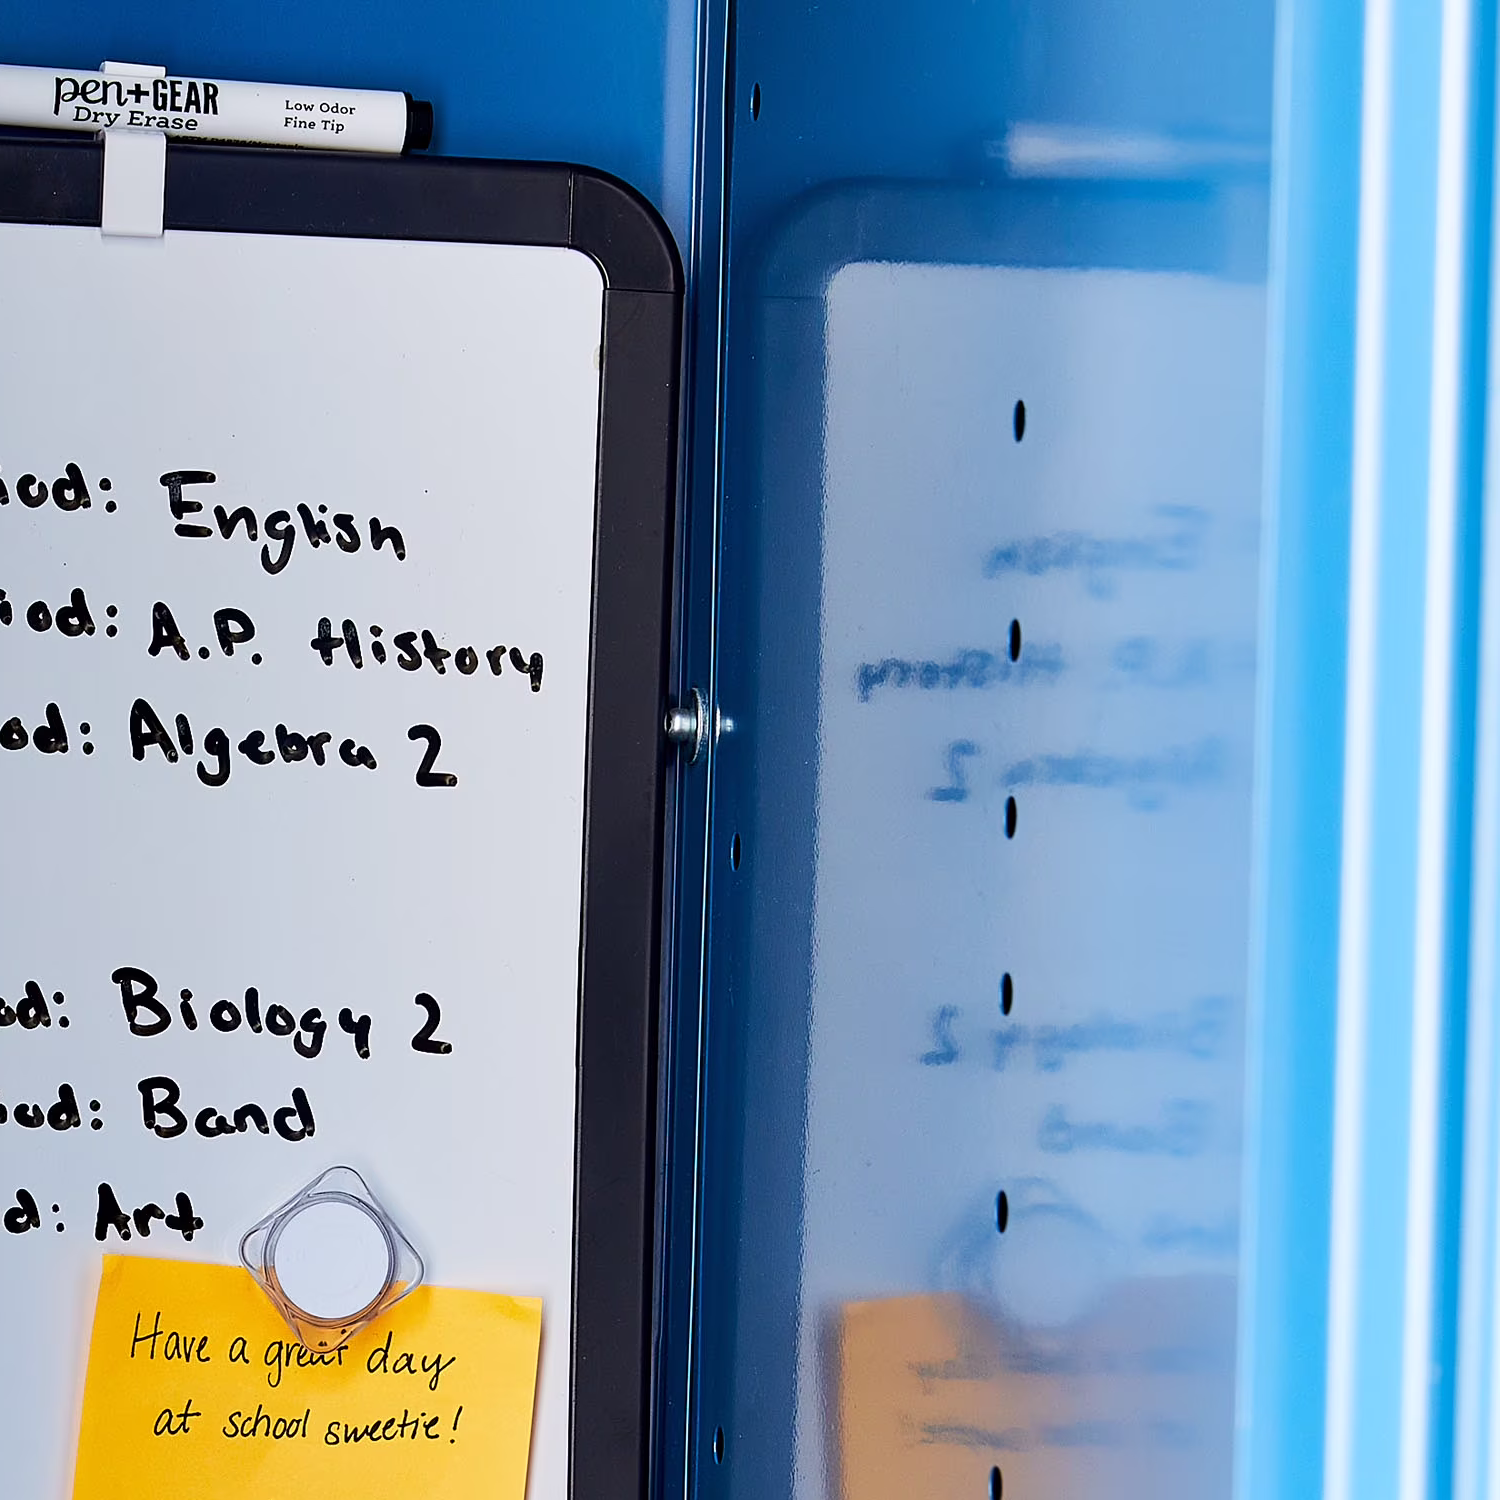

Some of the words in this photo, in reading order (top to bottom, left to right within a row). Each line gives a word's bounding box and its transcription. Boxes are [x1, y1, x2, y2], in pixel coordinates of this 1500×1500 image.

[71, 105, 121, 130] Dry
[126, 107, 200, 131] Erase
[283, 116, 316, 130] Fine
[320, 119, 345, 135] Tip
[285, 99, 315, 112] Low
[319, 102, 356, 115] Odor
[159, 470, 406, 575] English
[147, 601, 263, 665] A.P.
[310, 616, 544, 693] History
[129, 698, 378, 787] Algebra
[407, 724, 458, 788] 2
[111, 966, 372, 1060] Biology
[411, 992, 453, 1055] 2
[137, 1076, 316, 1142] Band
[94, 1182, 204, 1242] Art
[130, 1311, 211, 1363] Have
[228, 1336, 250, 1365] a
[366, 1330, 456, 1392] day
[153, 1398, 202, 1436] at
[222, 1403, 311, 1440] school
[324, 1405, 463, 1446] sweetie!
